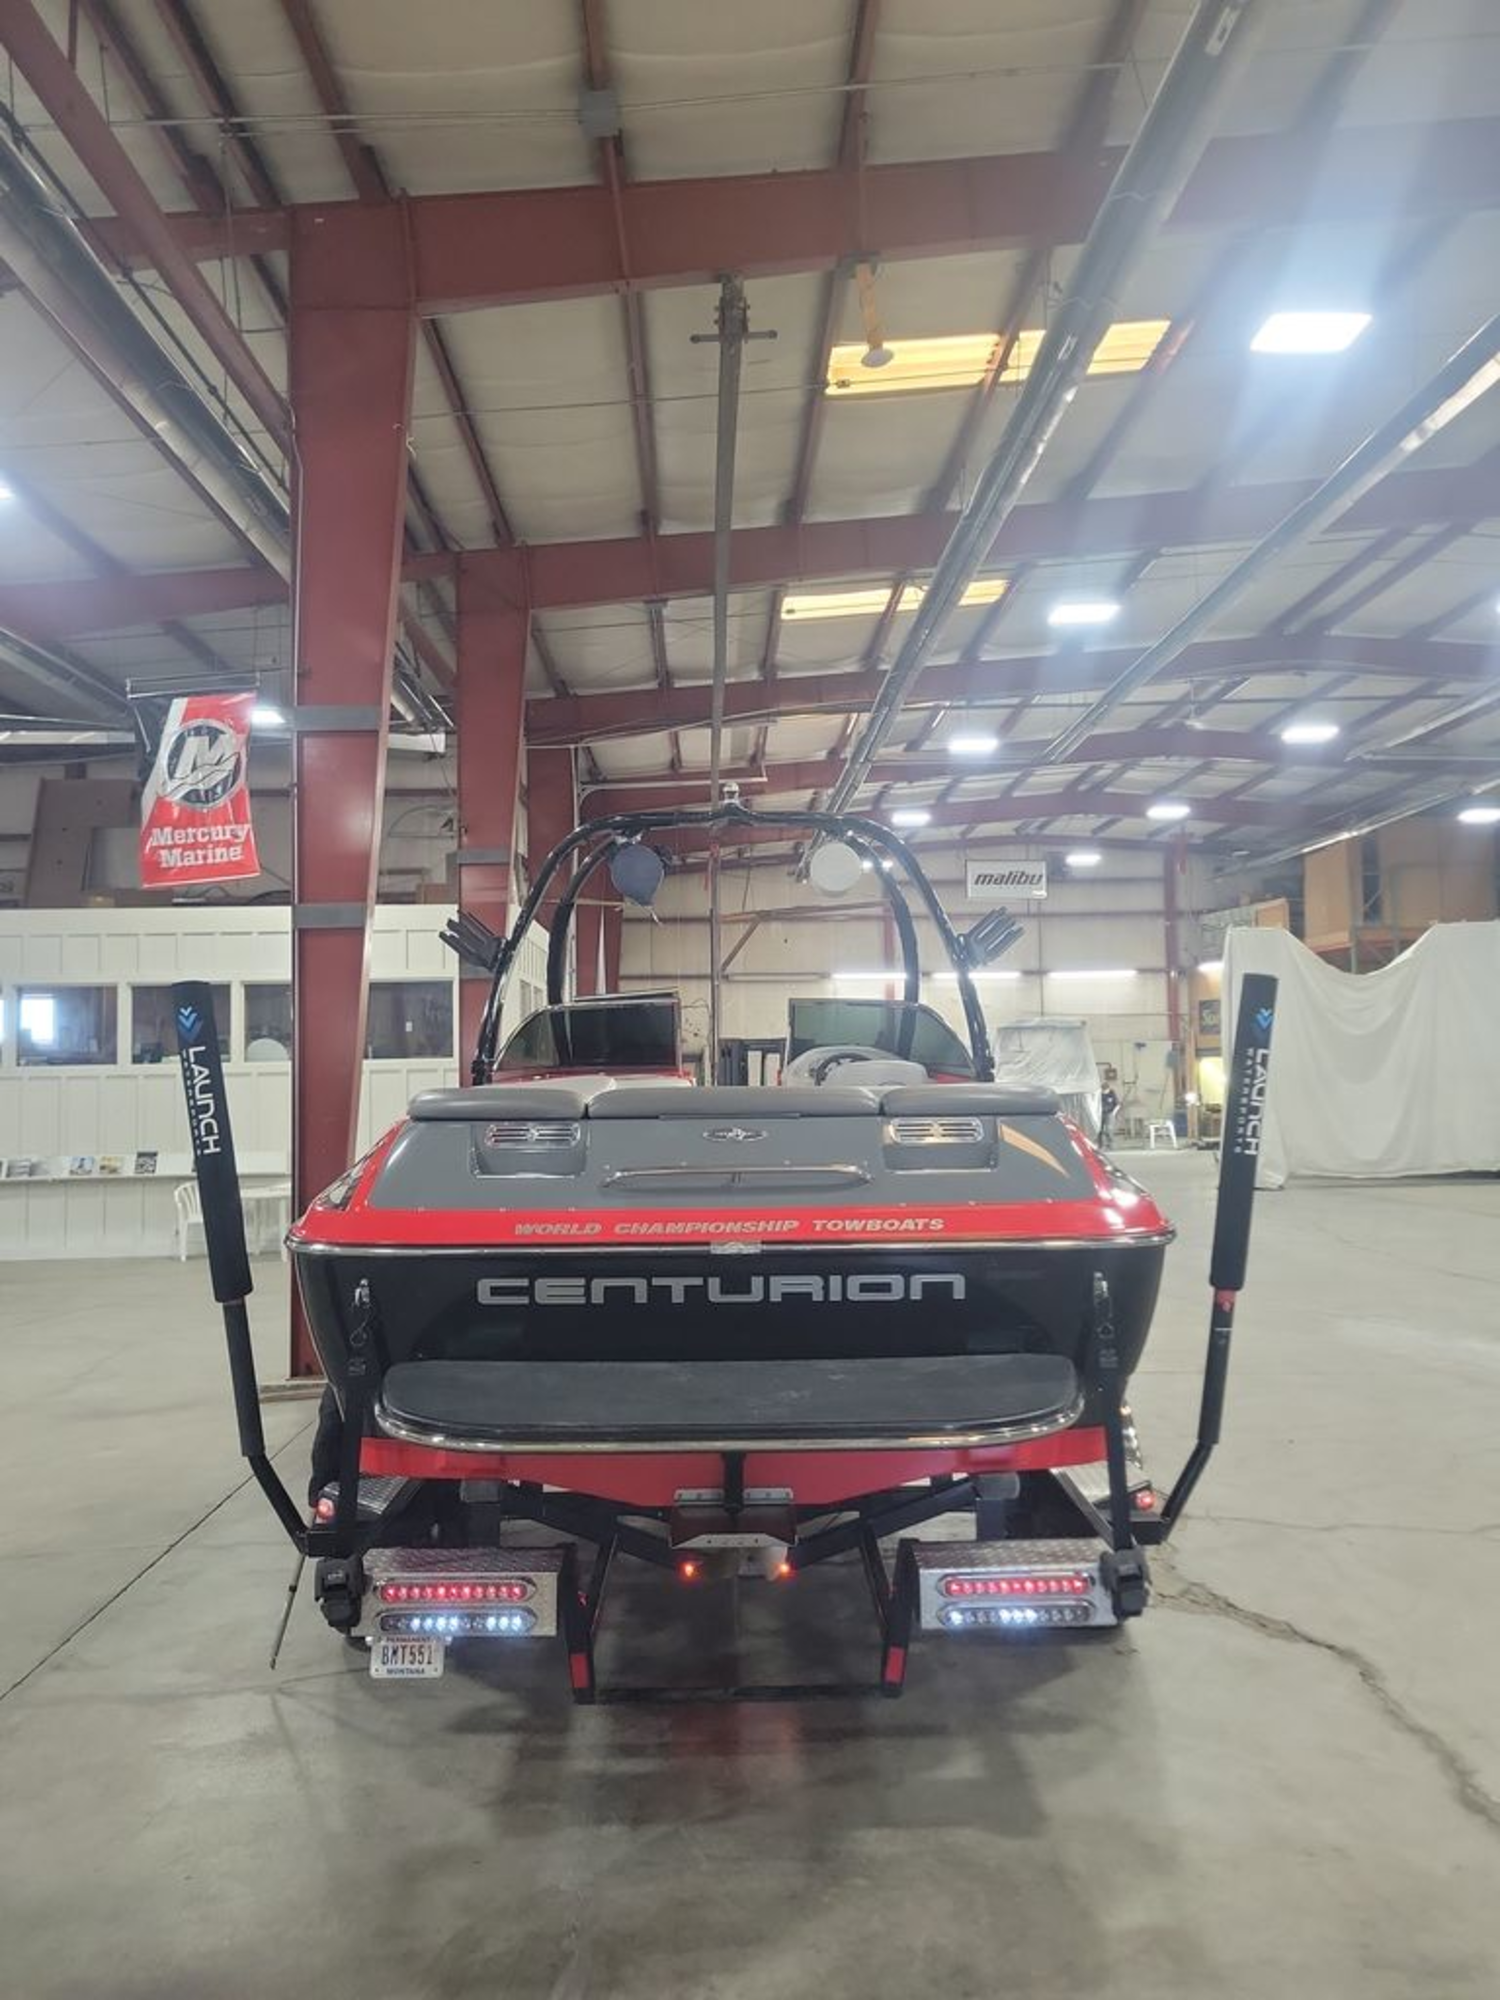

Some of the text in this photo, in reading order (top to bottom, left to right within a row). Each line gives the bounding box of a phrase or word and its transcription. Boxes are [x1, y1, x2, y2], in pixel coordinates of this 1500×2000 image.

[150, 823, 251, 847] Mercury
[159, 844, 243, 868] Marine
[974, 870, 1044, 886] malibu
[188, 1045, 222, 1155] LAUNCH
[514, 1217, 945, 1236] WORLD CHAMPIONSHIP TOWBOATS
[477, 1273, 966, 1305] CENTURION
